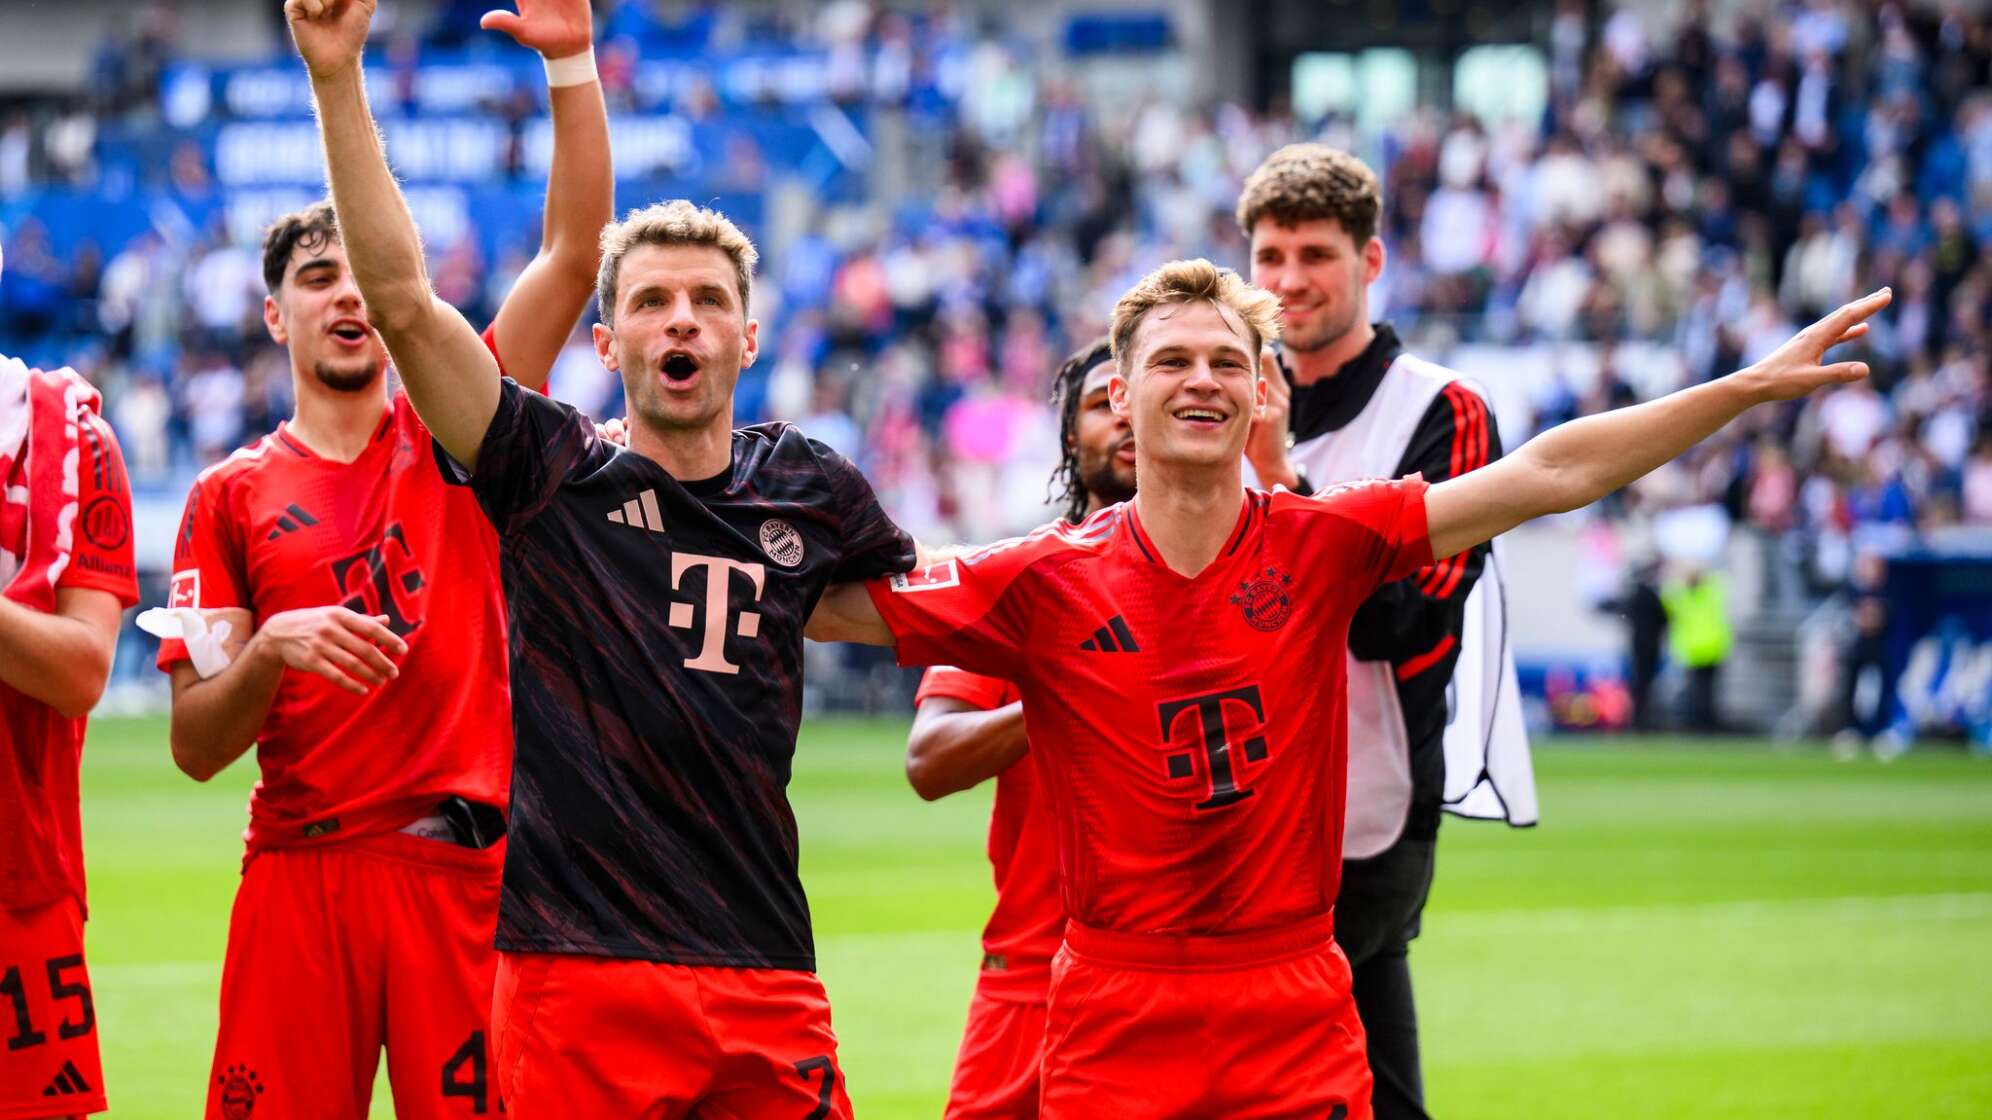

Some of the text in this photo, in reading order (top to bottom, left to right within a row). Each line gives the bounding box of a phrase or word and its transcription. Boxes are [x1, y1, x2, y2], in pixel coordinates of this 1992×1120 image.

[76, 553, 131, 577] Allianz
[765, 522, 795, 537] BAYERN
[668, 551, 766, 675] T
[1157, 684, 1269, 811] T
[0, 953, 95, 1051] 15
[442, 1029, 505, 1115] 4
[793, 1055, 835, 1120] 7
